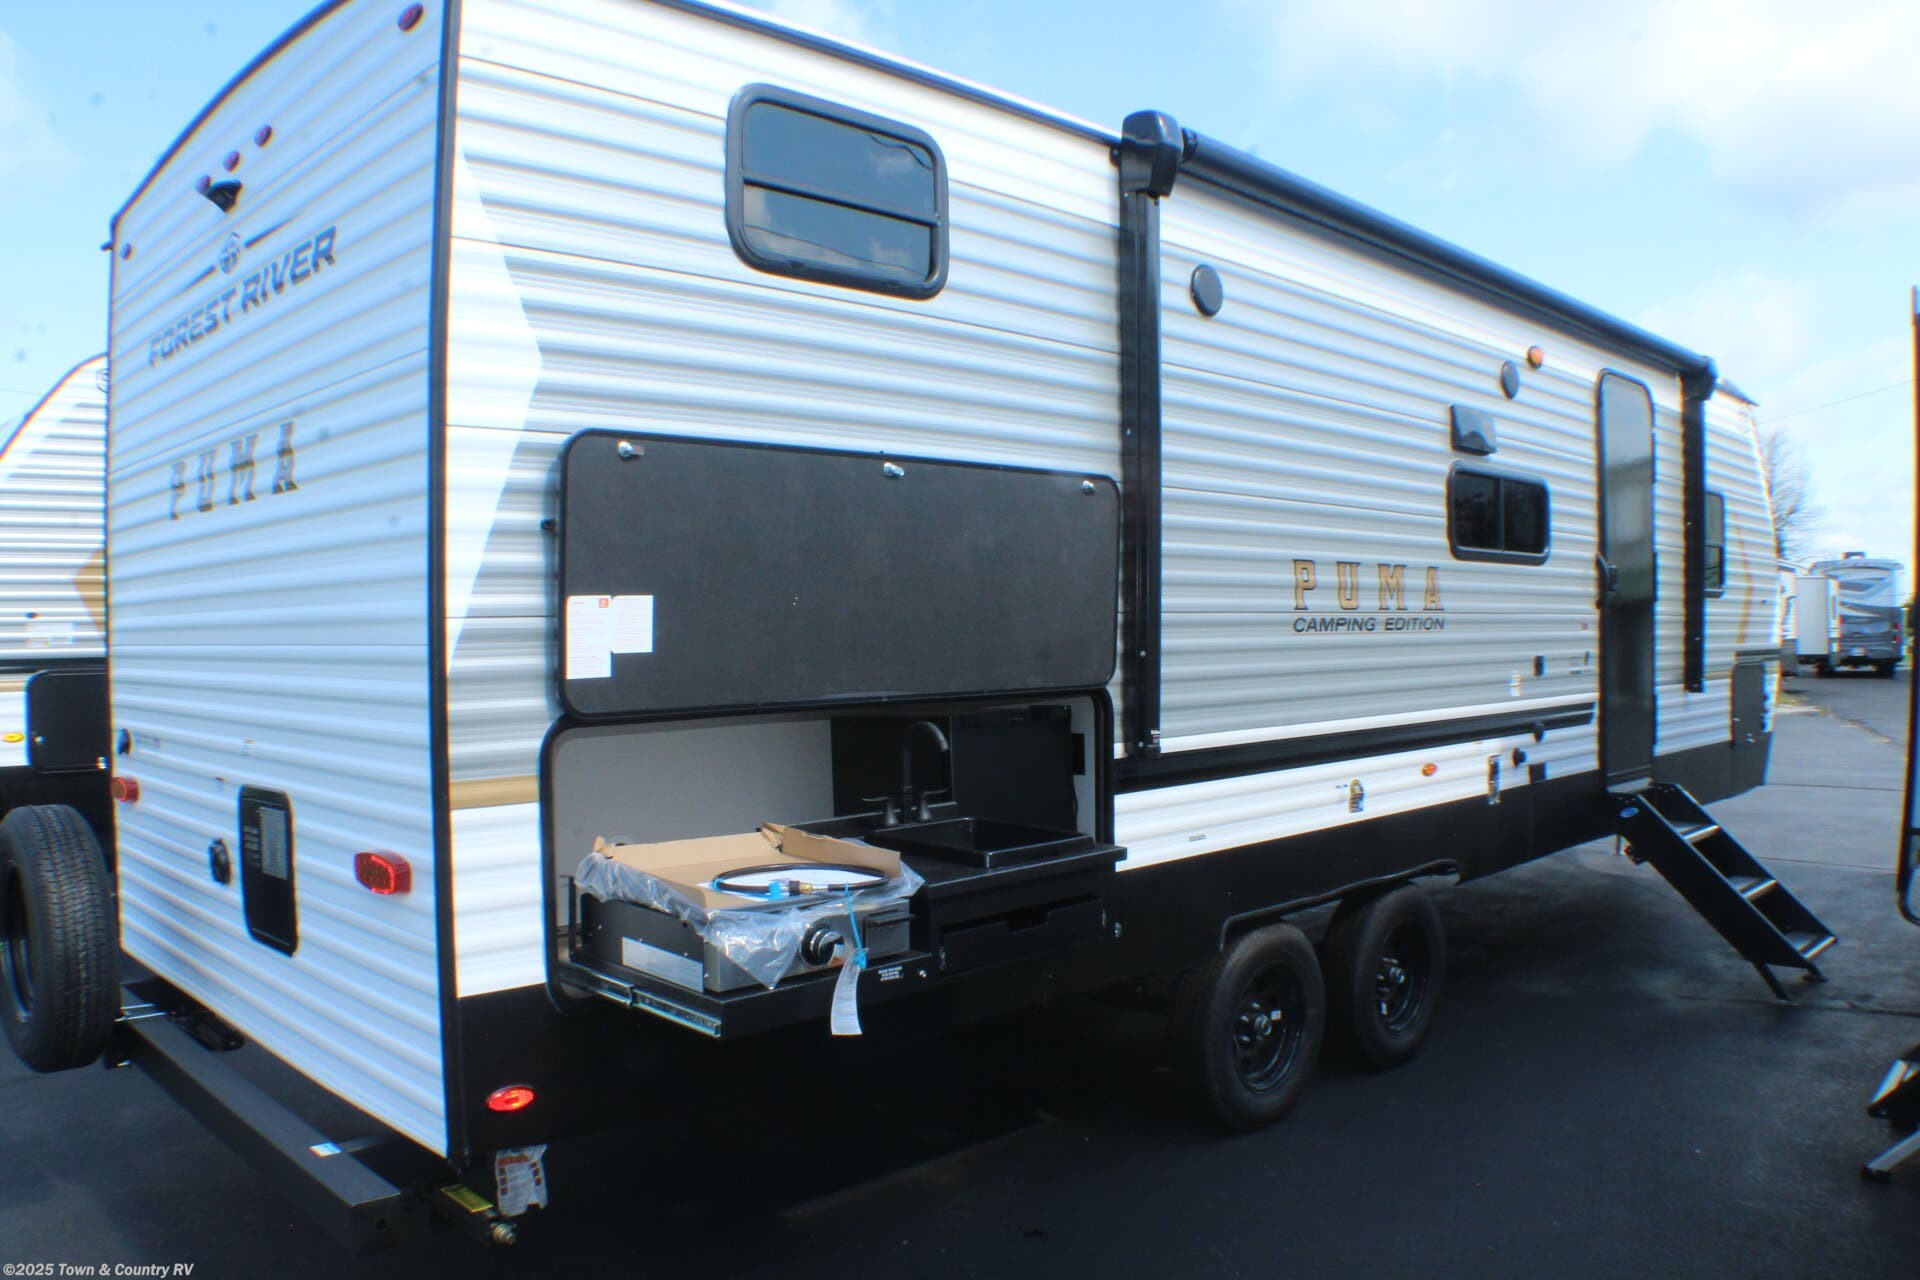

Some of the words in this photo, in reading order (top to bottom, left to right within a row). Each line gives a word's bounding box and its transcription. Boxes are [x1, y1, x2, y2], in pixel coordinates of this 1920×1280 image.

[147, 287, 240, 367] FOREST
[240, 225, 338, 313] RIVER
[169, 421, 299, 520] PUMA
[1292, 559, 1445, 611] PUMA
[1293, 617, 1376, 633] CAMPING
[1384, 617, 1446, 631] EDITION
